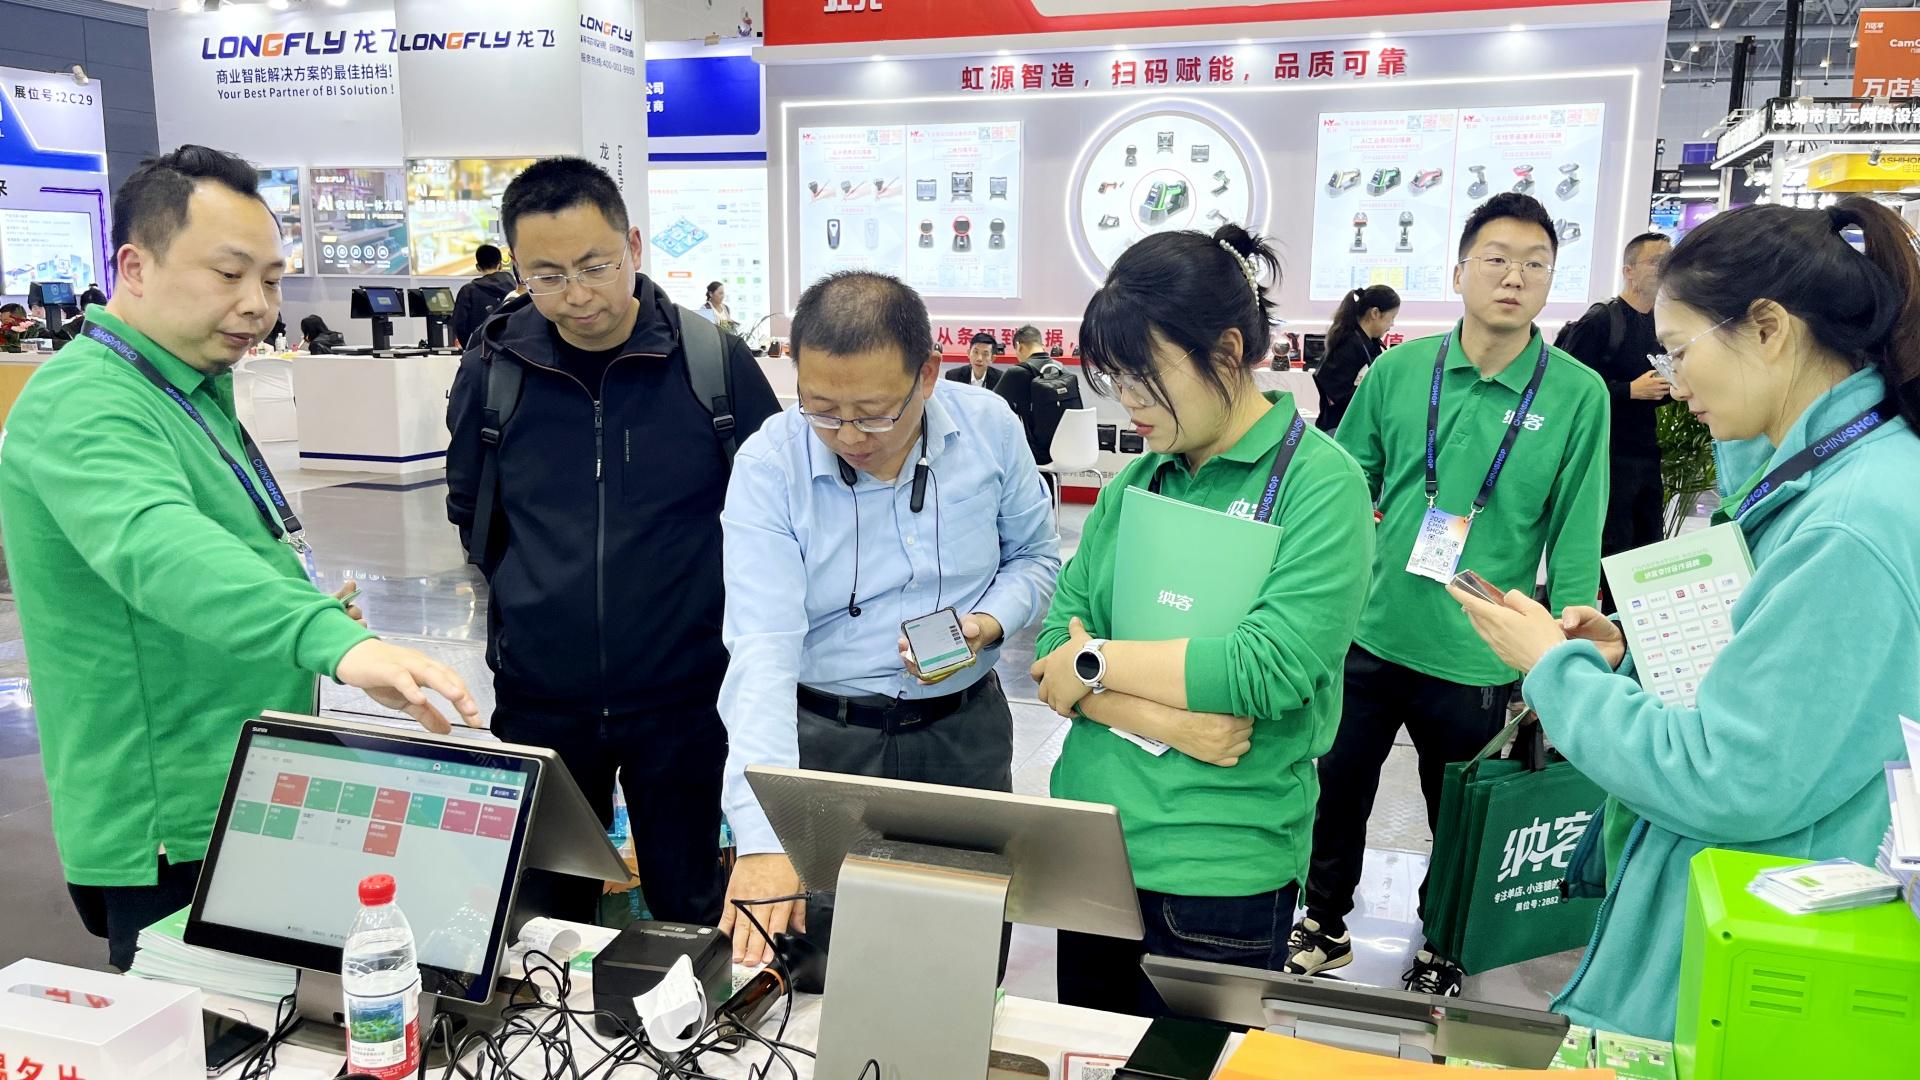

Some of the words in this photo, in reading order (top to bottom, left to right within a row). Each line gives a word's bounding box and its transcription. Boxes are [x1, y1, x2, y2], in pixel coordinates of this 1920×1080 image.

[400, 30, 511, 51] LONGFLY
[516, 29, 555, 48] 龙飞
[580, 14, 632, 42] LONGFLY
[202, 30, 346, 59] LONGFLY
[216, 64, 392, 85] 商业智能解决方案的最佳拍档!
[14, 85, 93, 106] 展位号:2C29
[218, 89, 241, 100] Your
[244, 88, 267, 99] Best
[270, 86, 309, 98] Partner
[313, 86, 323, 97] of
[327, 85, 337, 96] BI
[340, 84, 388, 96] Solution
[318, 194, 334, 211] AI
[1431, 367, 1441, 406] CHINASHOP
[1513, 388, 1534, 427] CHINASHOP
[1812, 411, 1882, 458] CHINASHOP
[1427, 429, 1436, 469] CHINASHOP
[1486, 448, 1507, 487] CHINASHOP
[253, 458, 285, 507] CHINASHOP
[1426, 526, 1446, 536] SHOP
[1428, 521, 1449, 532] CHINA
[1429, 516, 1447, 524] 2026
[1156, 588, 1196, 613] 纳客
[1497, 811, 1594, 883] 纳客
